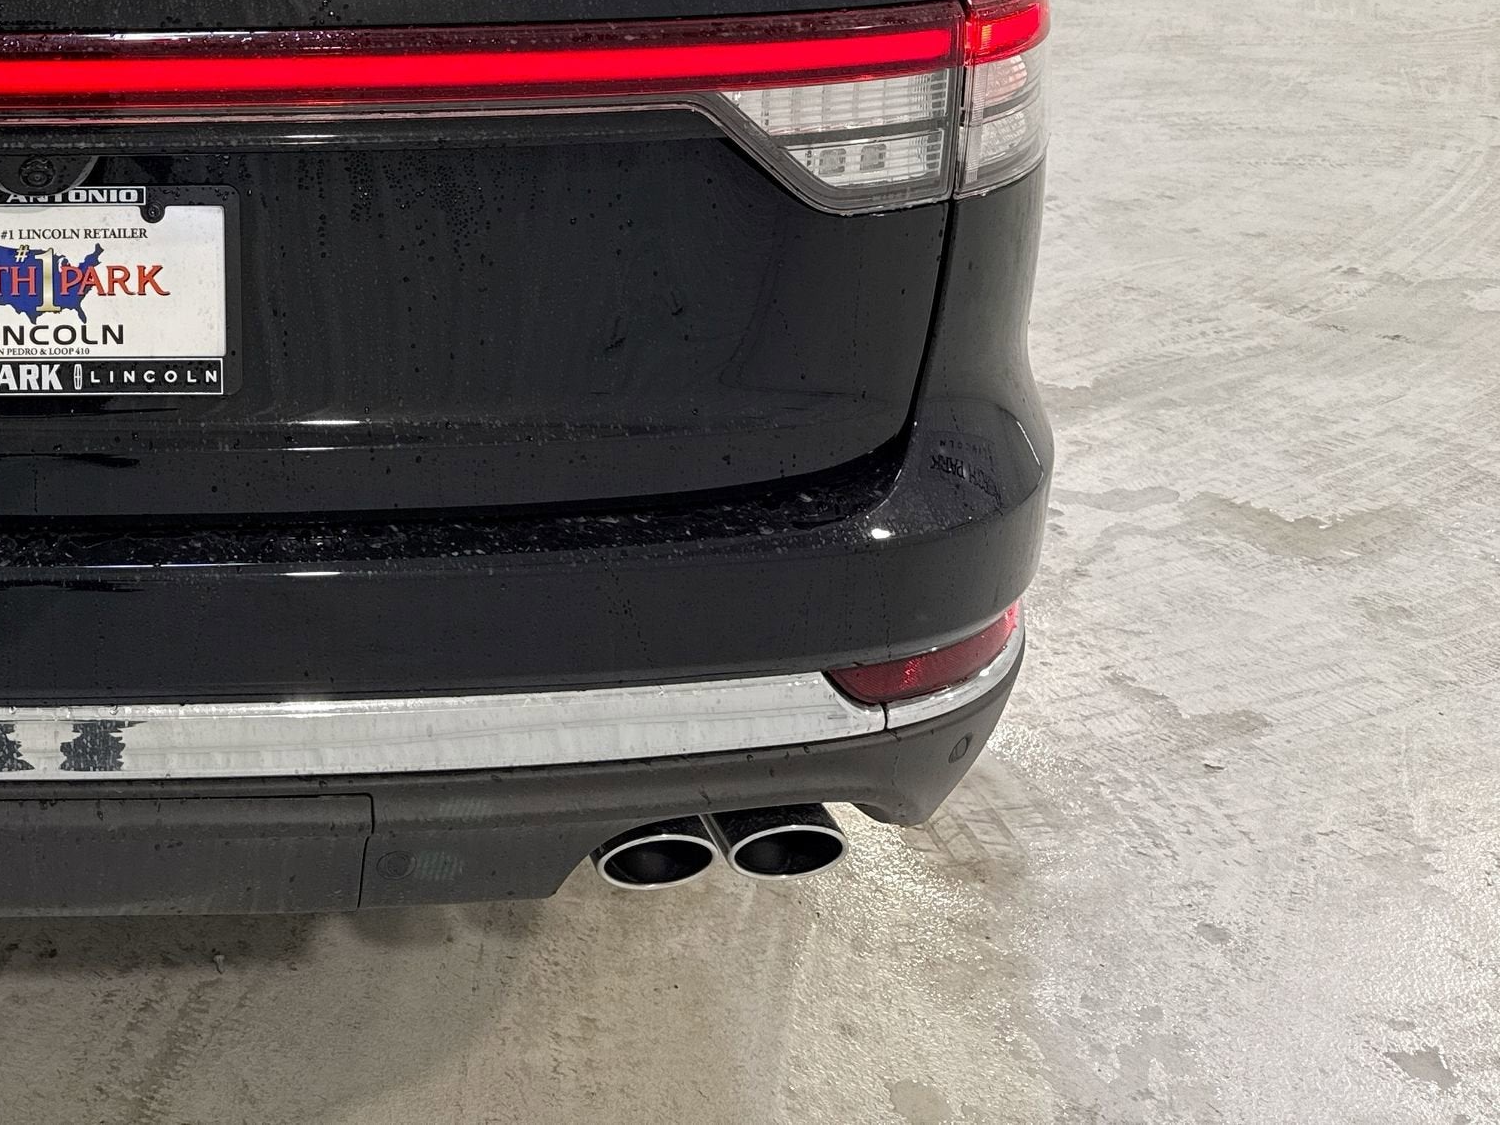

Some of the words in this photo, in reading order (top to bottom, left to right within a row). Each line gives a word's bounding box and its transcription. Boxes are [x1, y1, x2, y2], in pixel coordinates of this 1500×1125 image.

[1, 229, 14, 240] #1
[18, 228, 80, 240] LINCOLN
[84, 227, 148, 239] RETAILER
[59, 263, 170, 297] PARK
[7, 348, 38, 356] PEDRO
[49, 347, 75, 356] LOOP
[75, 347, 90, 355] 410
[91, 370, 218, 384] LINCOLN
